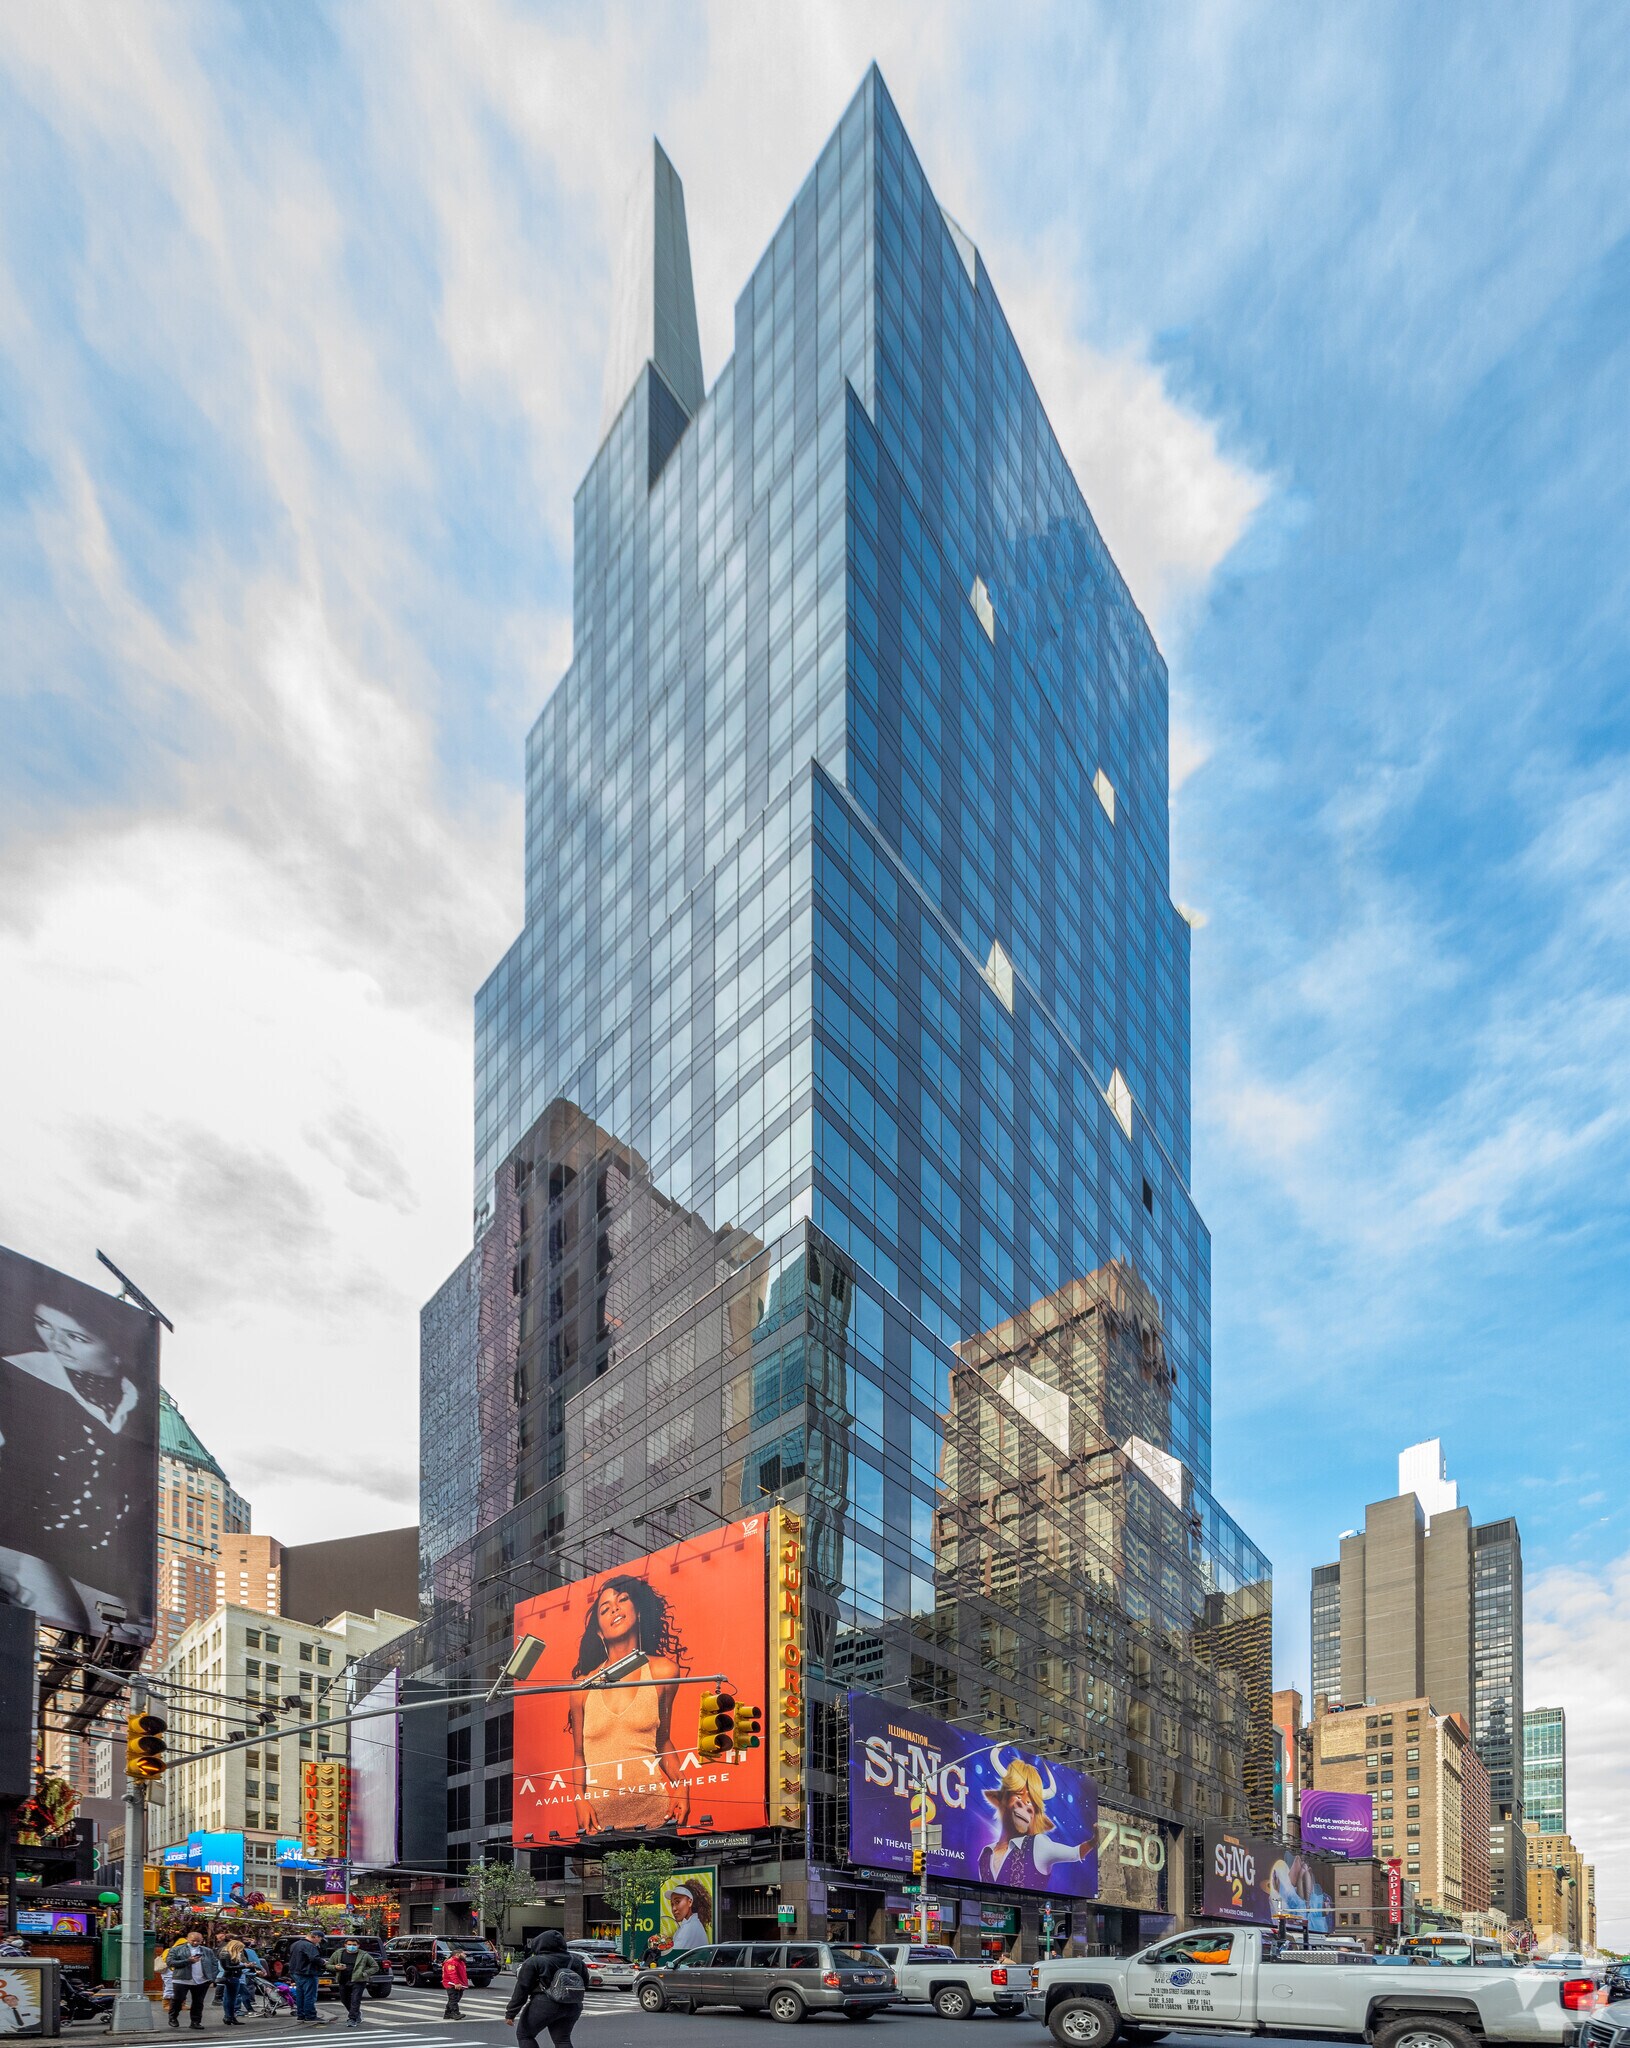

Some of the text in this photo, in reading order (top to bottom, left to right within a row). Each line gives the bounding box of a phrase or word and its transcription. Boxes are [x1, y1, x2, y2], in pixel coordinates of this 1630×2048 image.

[785, 1540, 800, 1718] JUNIORS
[888, 1724, 928, 1746] ILLUMINATION
[865, 1736, 969, 1809] SING
[535, 1773, 730, 1807] AVAILABLE EVERYWHERE
[306, 1763, 318, 1847] JUNIORS
[1306, 1822, 1369, 1833] Least complicated.
[1313, 1816, 1362, 1826] Most watched.
[873, 1836, 883, 1846] IN
[885, 1838, 912, 1851] THEATE
[1098, 1819, 1165, 1872] 750
[202, 1864, 240, 1875] JUDGE?
[1215, 1843, 1256, 1886] SING
[196, 1876, 211, 1892] 12
[326, 1881, 344, 1889] SIX
[1232, 1878, 1243, 1907] 2
